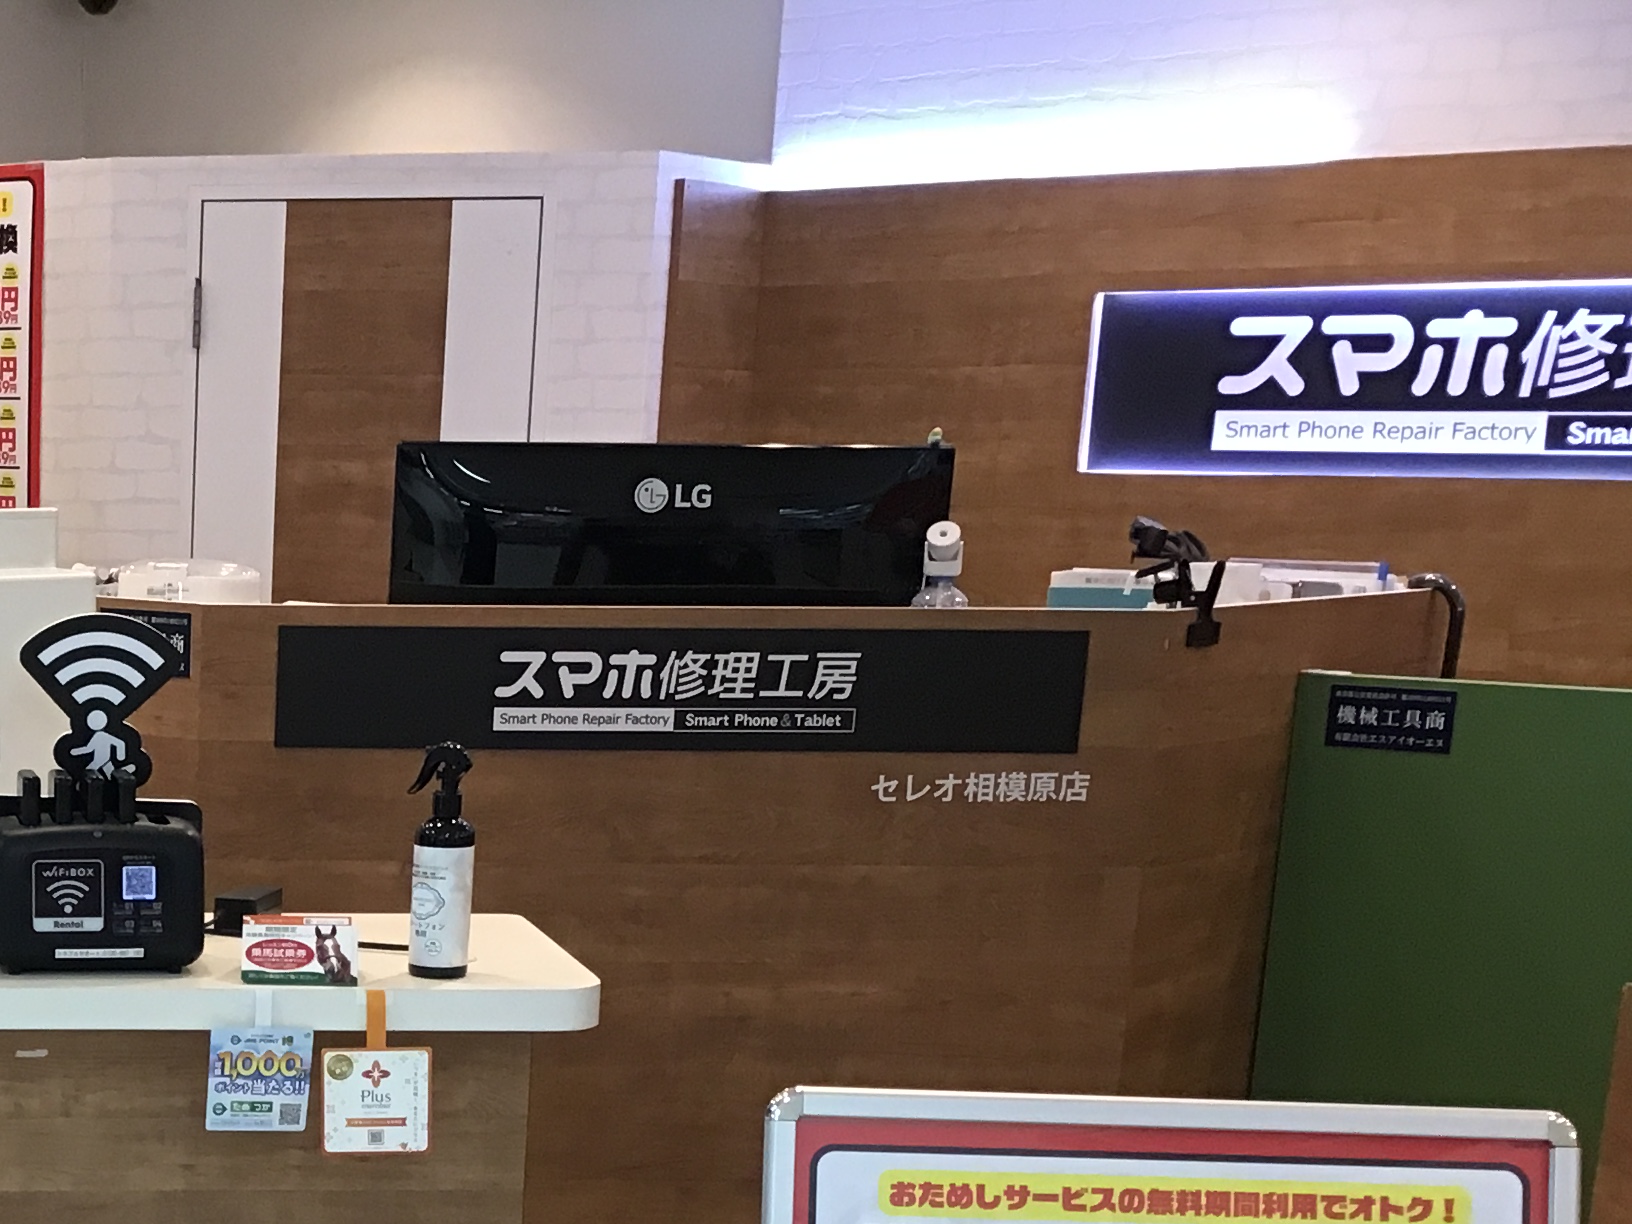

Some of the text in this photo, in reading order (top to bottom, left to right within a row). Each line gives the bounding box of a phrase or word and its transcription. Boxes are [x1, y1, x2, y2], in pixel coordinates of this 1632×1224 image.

[1218, 308, 1632, 398] スマホ修
[1225, 421, 1536, 443] Smart Phone Repair Factory
[1567, 421, 1632, 445] Sma
[675, 484, 712, 508] LG
[494, 650, 862, 700] スマホ修理工房
[500, 714, 669, 728] Smart Phone Repair Factory
[685, 714, 841, 727] Smart Phone & Tablet
[1337, 705, 1446, 730] 機械工具商
[871, 771, 1090, 802] セレオ相模原店
[54, 920, 83, 929] Rental
